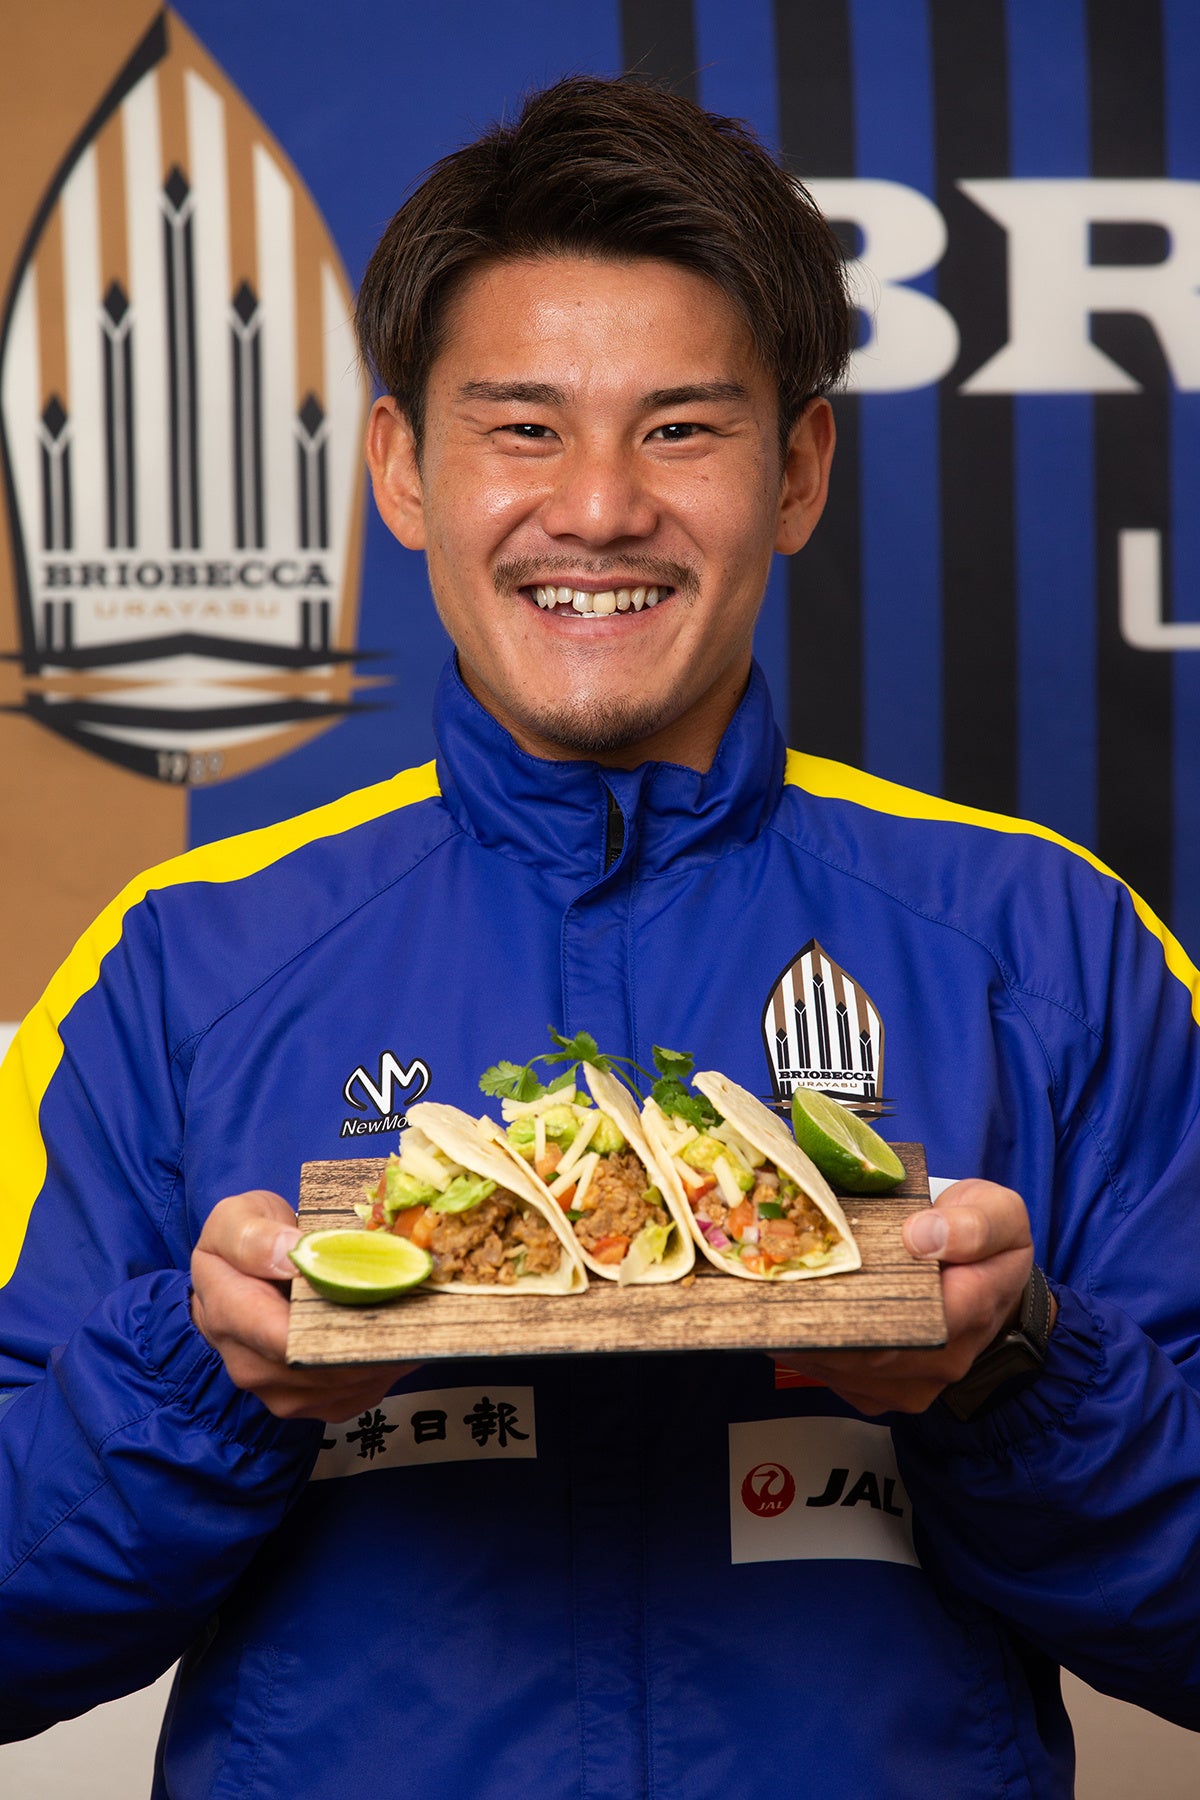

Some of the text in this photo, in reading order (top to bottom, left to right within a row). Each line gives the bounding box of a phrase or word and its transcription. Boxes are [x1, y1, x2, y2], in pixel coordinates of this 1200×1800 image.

[44, 560, 330, 588] BRIOBECCA
[93, 600, 281, 621] URAYASU
[778, 1070, 876, 1081] BRIOBECCA
[341, 1114, 411, 1137] NewMo
[320, 1396, 530, 1461] 葉日報
[806, 1468, 904, 1518] JAL
[757, 1500, 785, 1511] JAL
